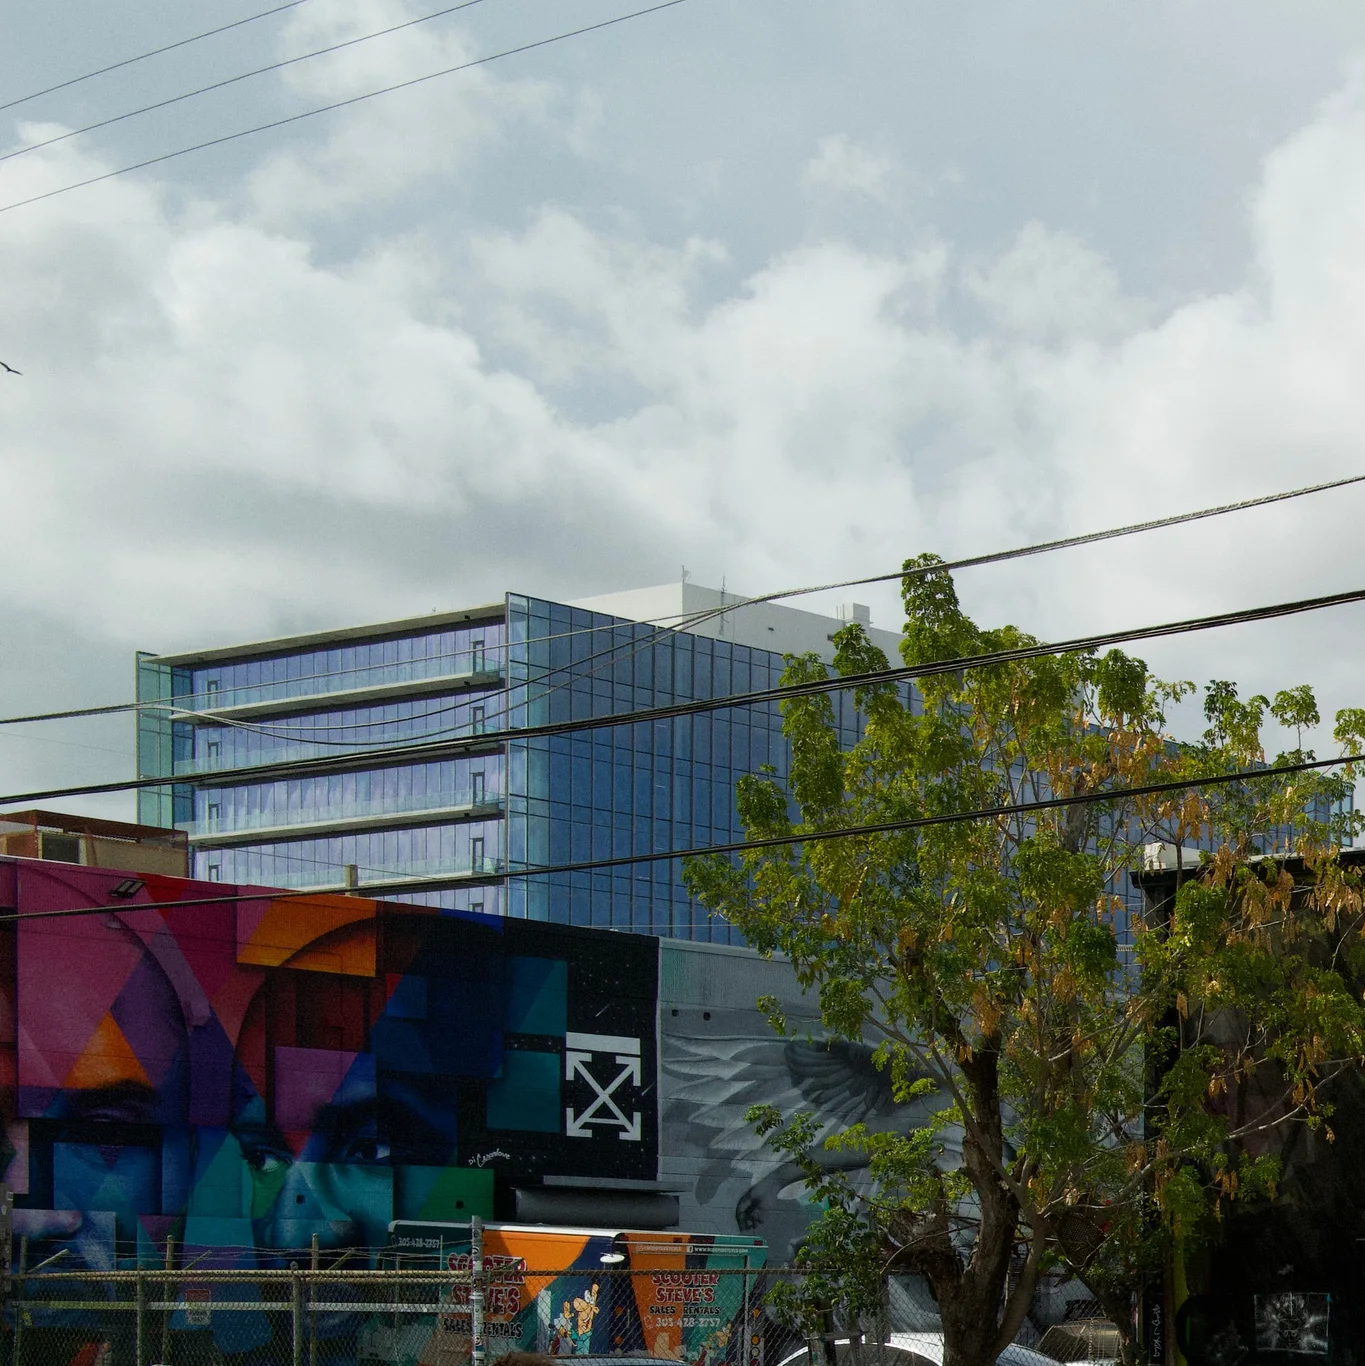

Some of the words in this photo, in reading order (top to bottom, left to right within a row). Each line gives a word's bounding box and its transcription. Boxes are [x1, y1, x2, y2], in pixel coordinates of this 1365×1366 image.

[651, 1272, 720, 1288] SCOOTER
[655, 1286, 716, 1304] STEVE'S
[649, 1305, 677, 1315] SALES
[683, 1305, 721, 1315] RENTALS
